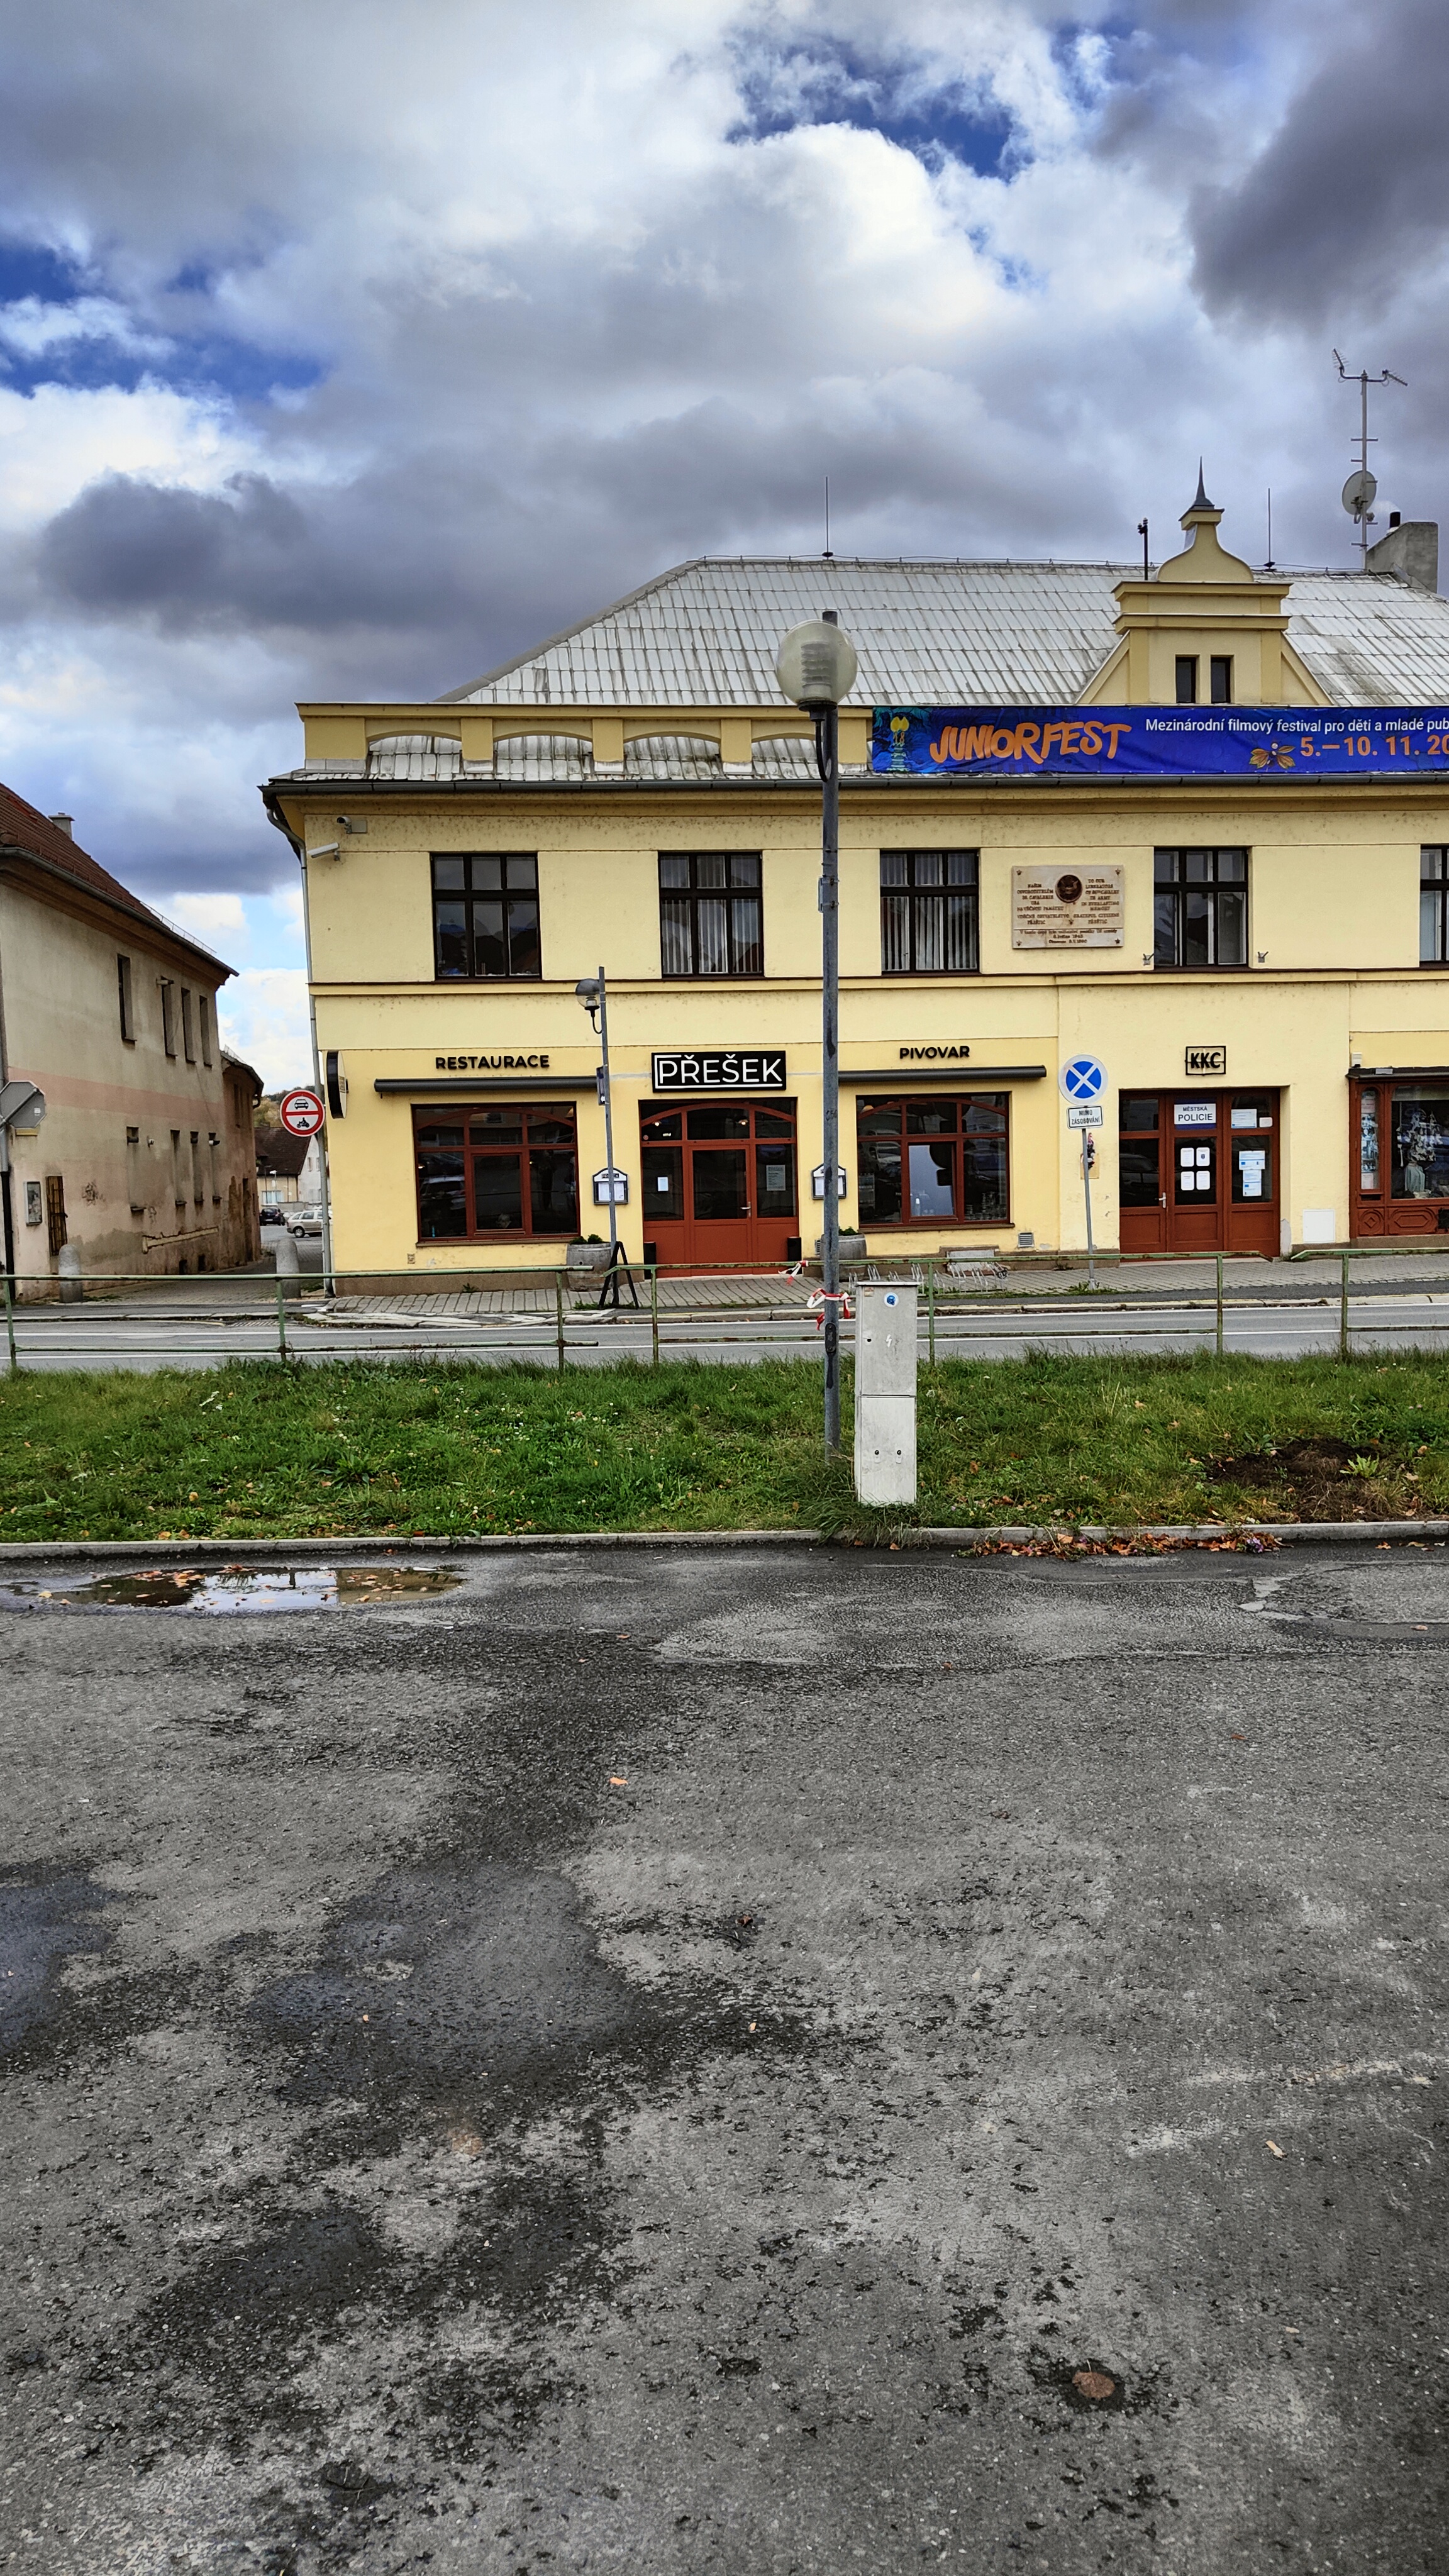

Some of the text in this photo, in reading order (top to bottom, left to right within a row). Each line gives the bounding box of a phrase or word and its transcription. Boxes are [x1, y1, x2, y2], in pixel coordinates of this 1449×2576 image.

[1146, 717, 1449, 735] Mezinárodní filmový festival pro děti a mladé pub
[930, 721, 1131, 764] JUNIORFEST
[1385, 735, 1419, 755] 11.
[899, 1046, 970, 1059] PIVOVAR
[1191, 1052, 1221, 1069] KKC
[435, 1055, 550, 1070] RESTAURACE
[659, 1054, 782, 1084] PŘEŠEK
[1071, 1116, 1100, 1124] ZÁSOBOVÁNÍ
